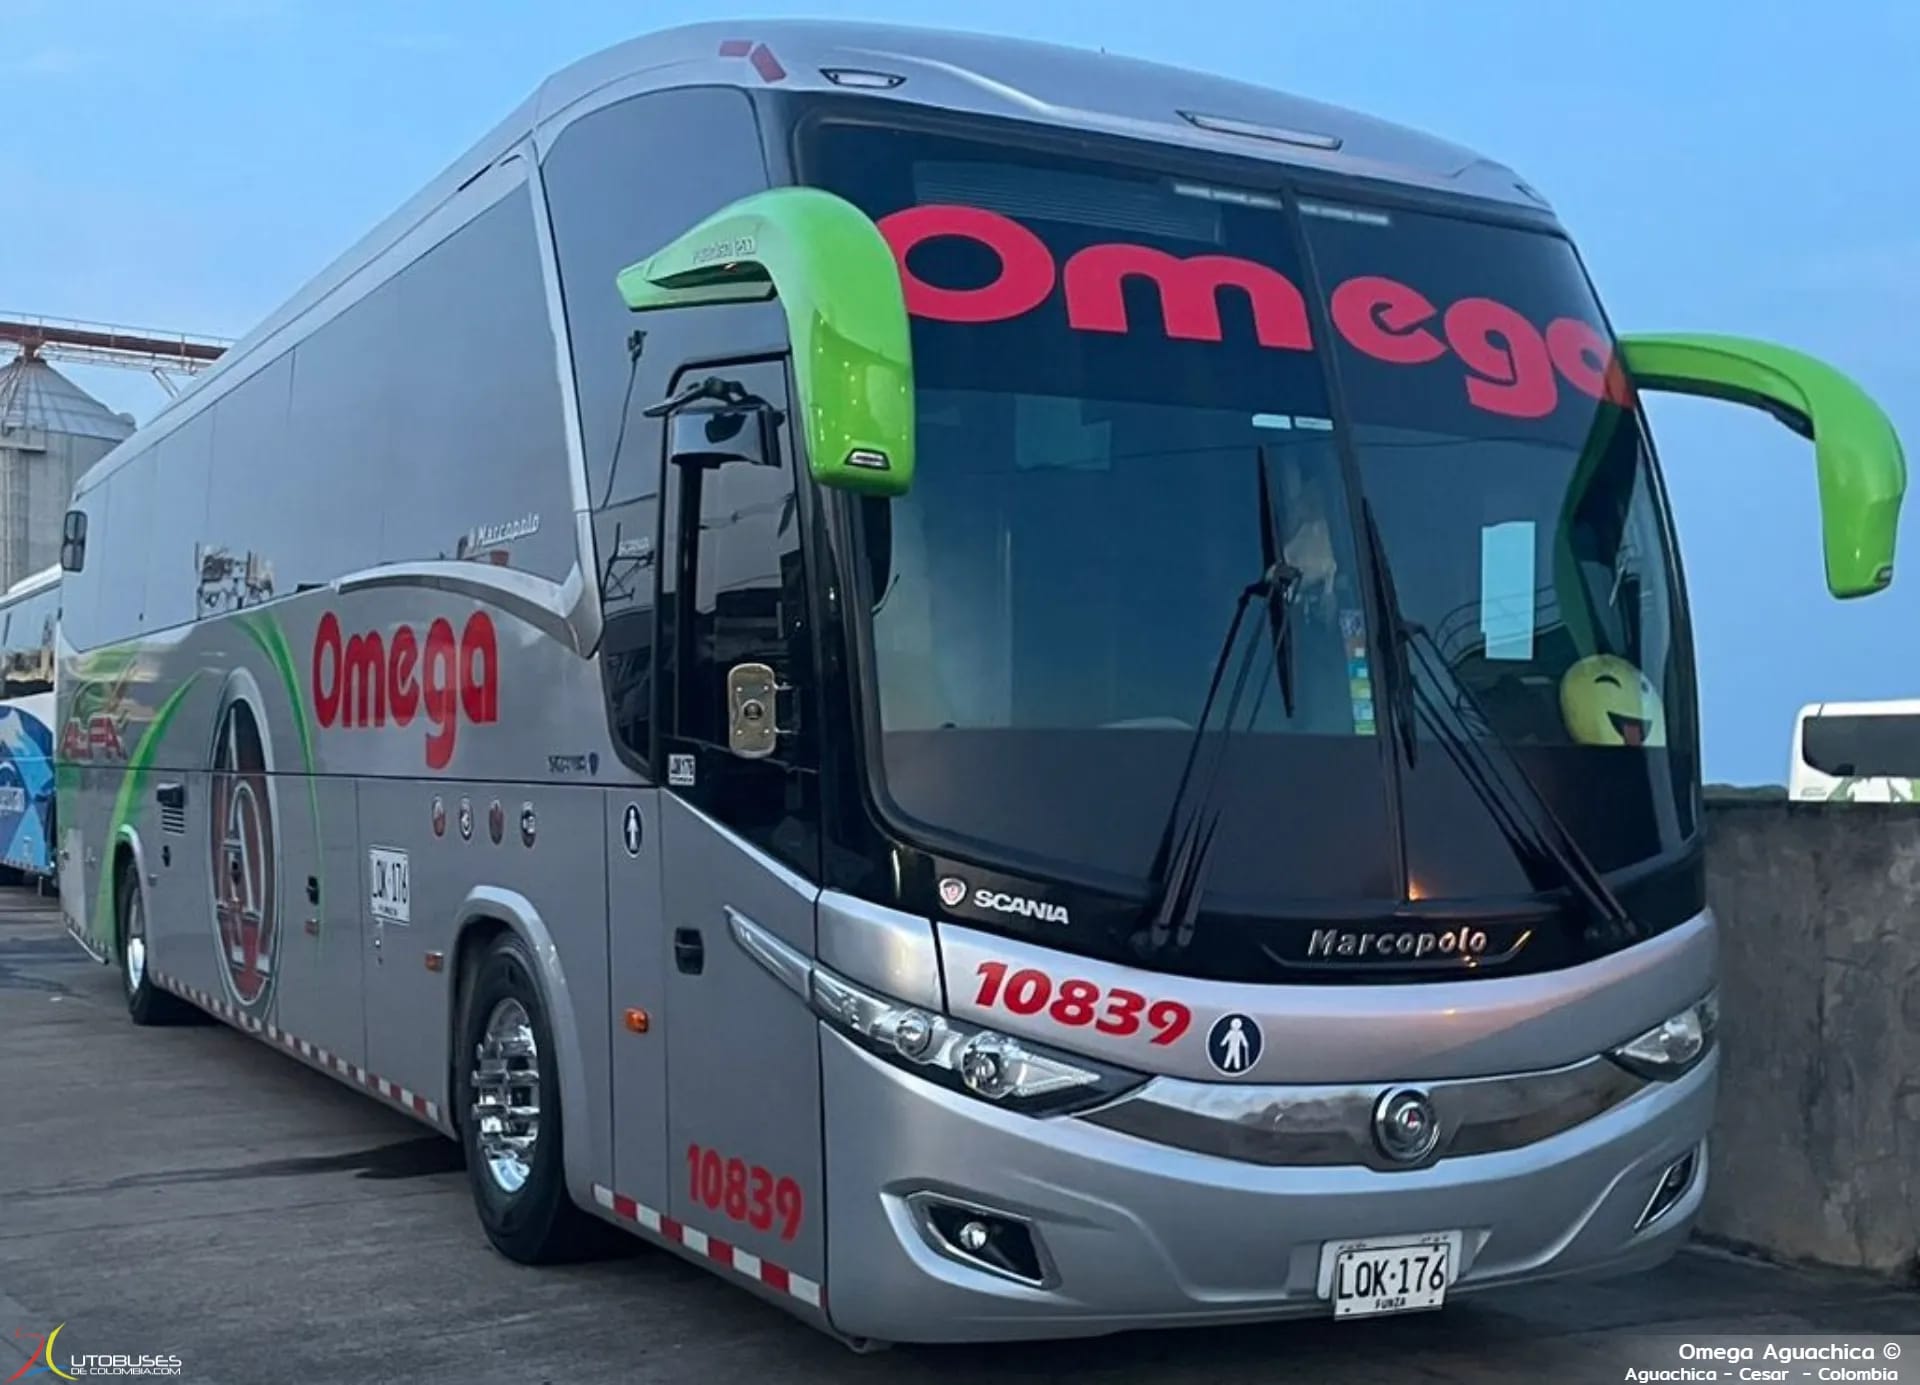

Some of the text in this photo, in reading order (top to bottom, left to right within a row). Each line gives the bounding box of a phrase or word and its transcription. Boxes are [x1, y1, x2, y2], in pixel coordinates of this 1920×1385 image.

[877, 204, 1636, 418] Omega
[312, 610, 499, 770] Omega
[973, 889, 1070, 925] SCANIA
[1307, 926, 1488, 957] Marcopolo
[974, 961, 1192, 1046] 10839
[687, 1142, 803, 1243] 10839
